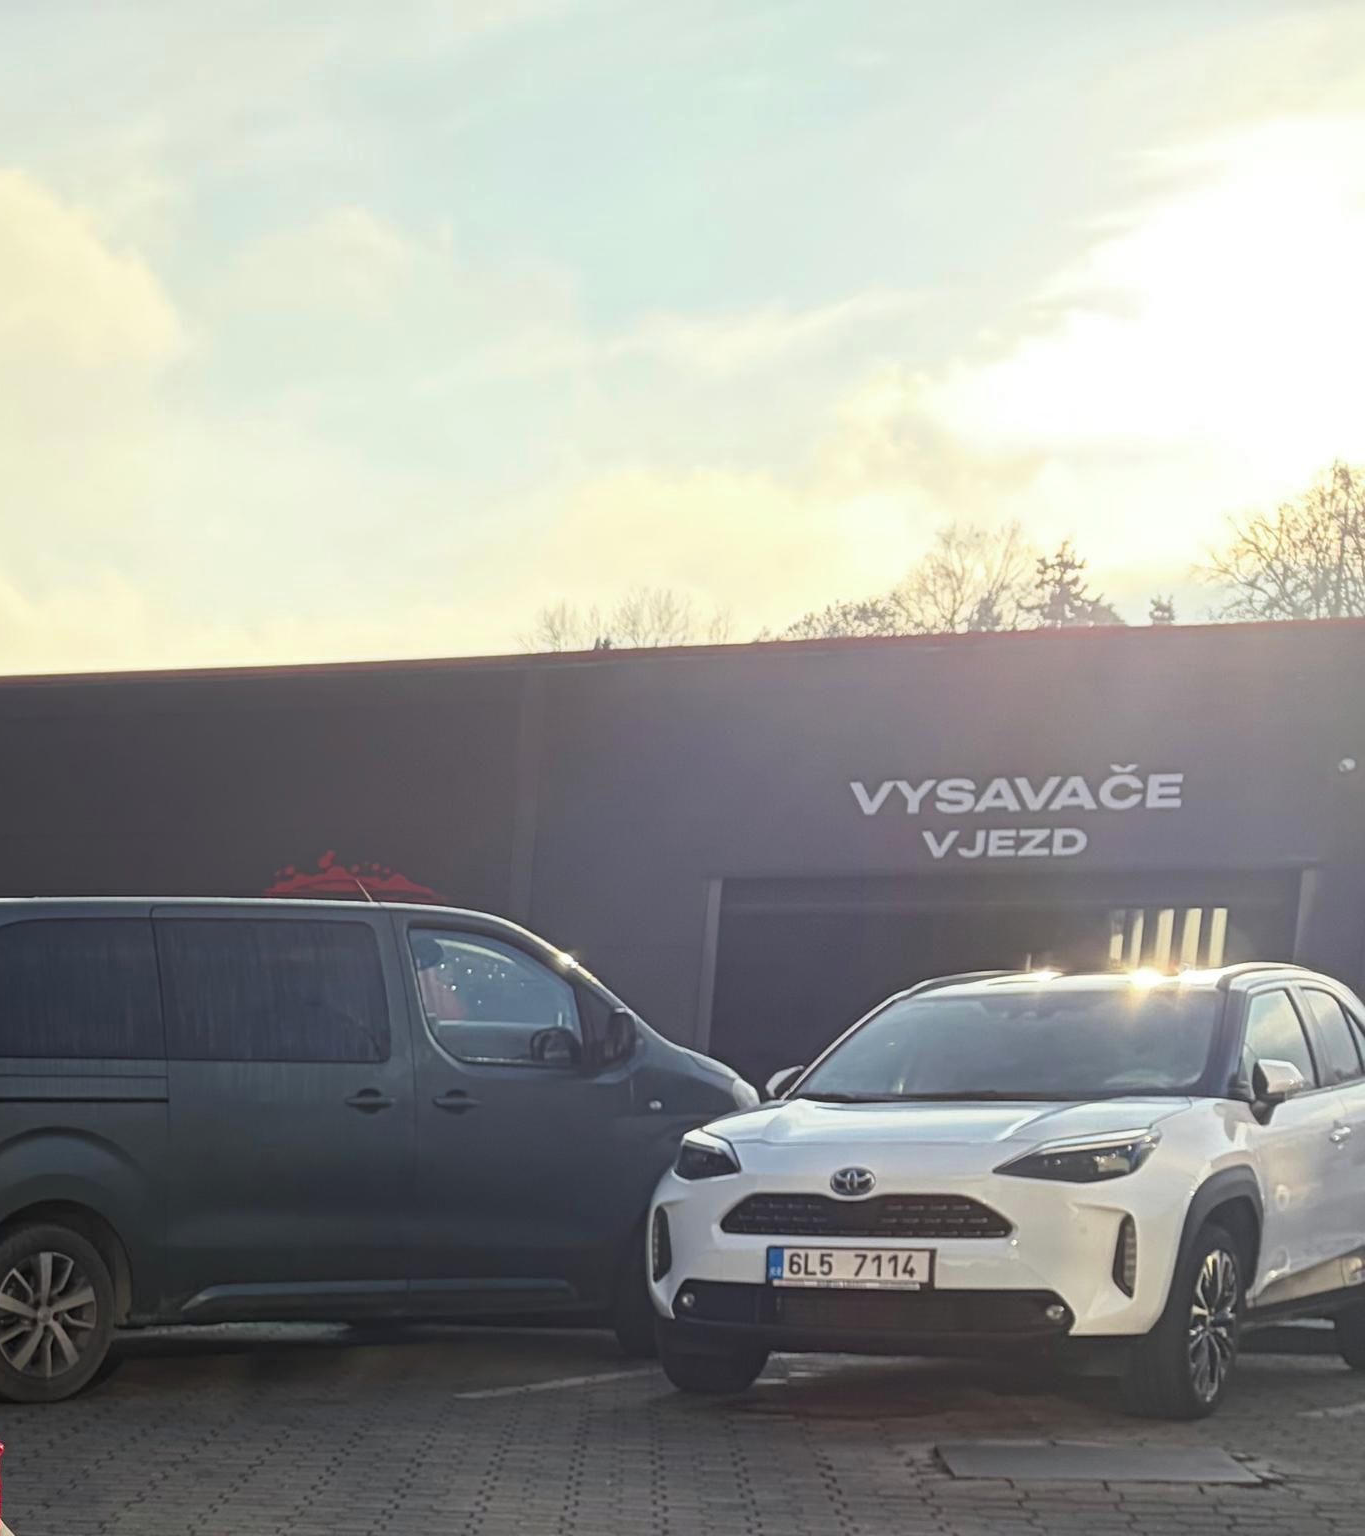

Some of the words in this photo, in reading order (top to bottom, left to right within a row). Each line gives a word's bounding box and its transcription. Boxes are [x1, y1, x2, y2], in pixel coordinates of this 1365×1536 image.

[850, 763, 1184, 816] VYSAVAČE
[921, 828, 1088, 859] VJEZD
[788, 1253, 833, 1277] 6L5
[854, 1253, 916, 1278] 7114
